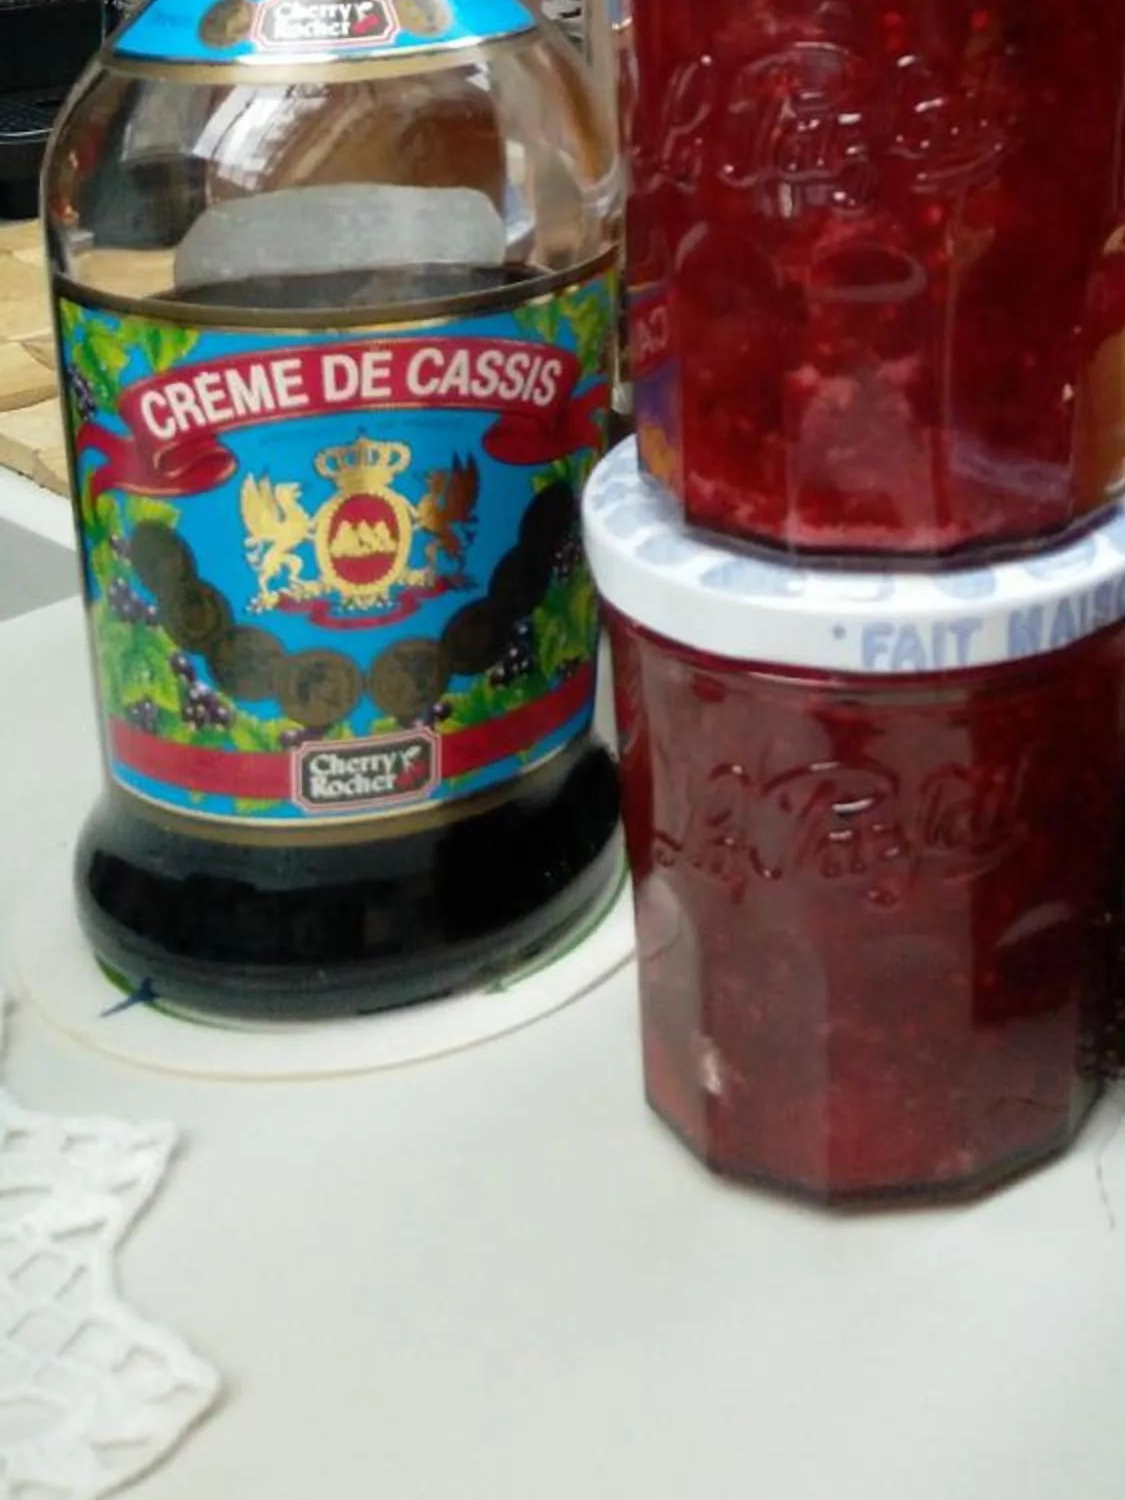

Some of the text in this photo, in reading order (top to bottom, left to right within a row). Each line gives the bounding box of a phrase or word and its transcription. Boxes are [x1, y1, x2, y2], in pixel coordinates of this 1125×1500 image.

[322, 350, 392, 401] DE
[406, 347, 563, 407] CASSIS
[861, 616, 985, 672] FAIT
[310, 751, 397, 777] Cherry
[310, 773, 397, 798] Rocher
